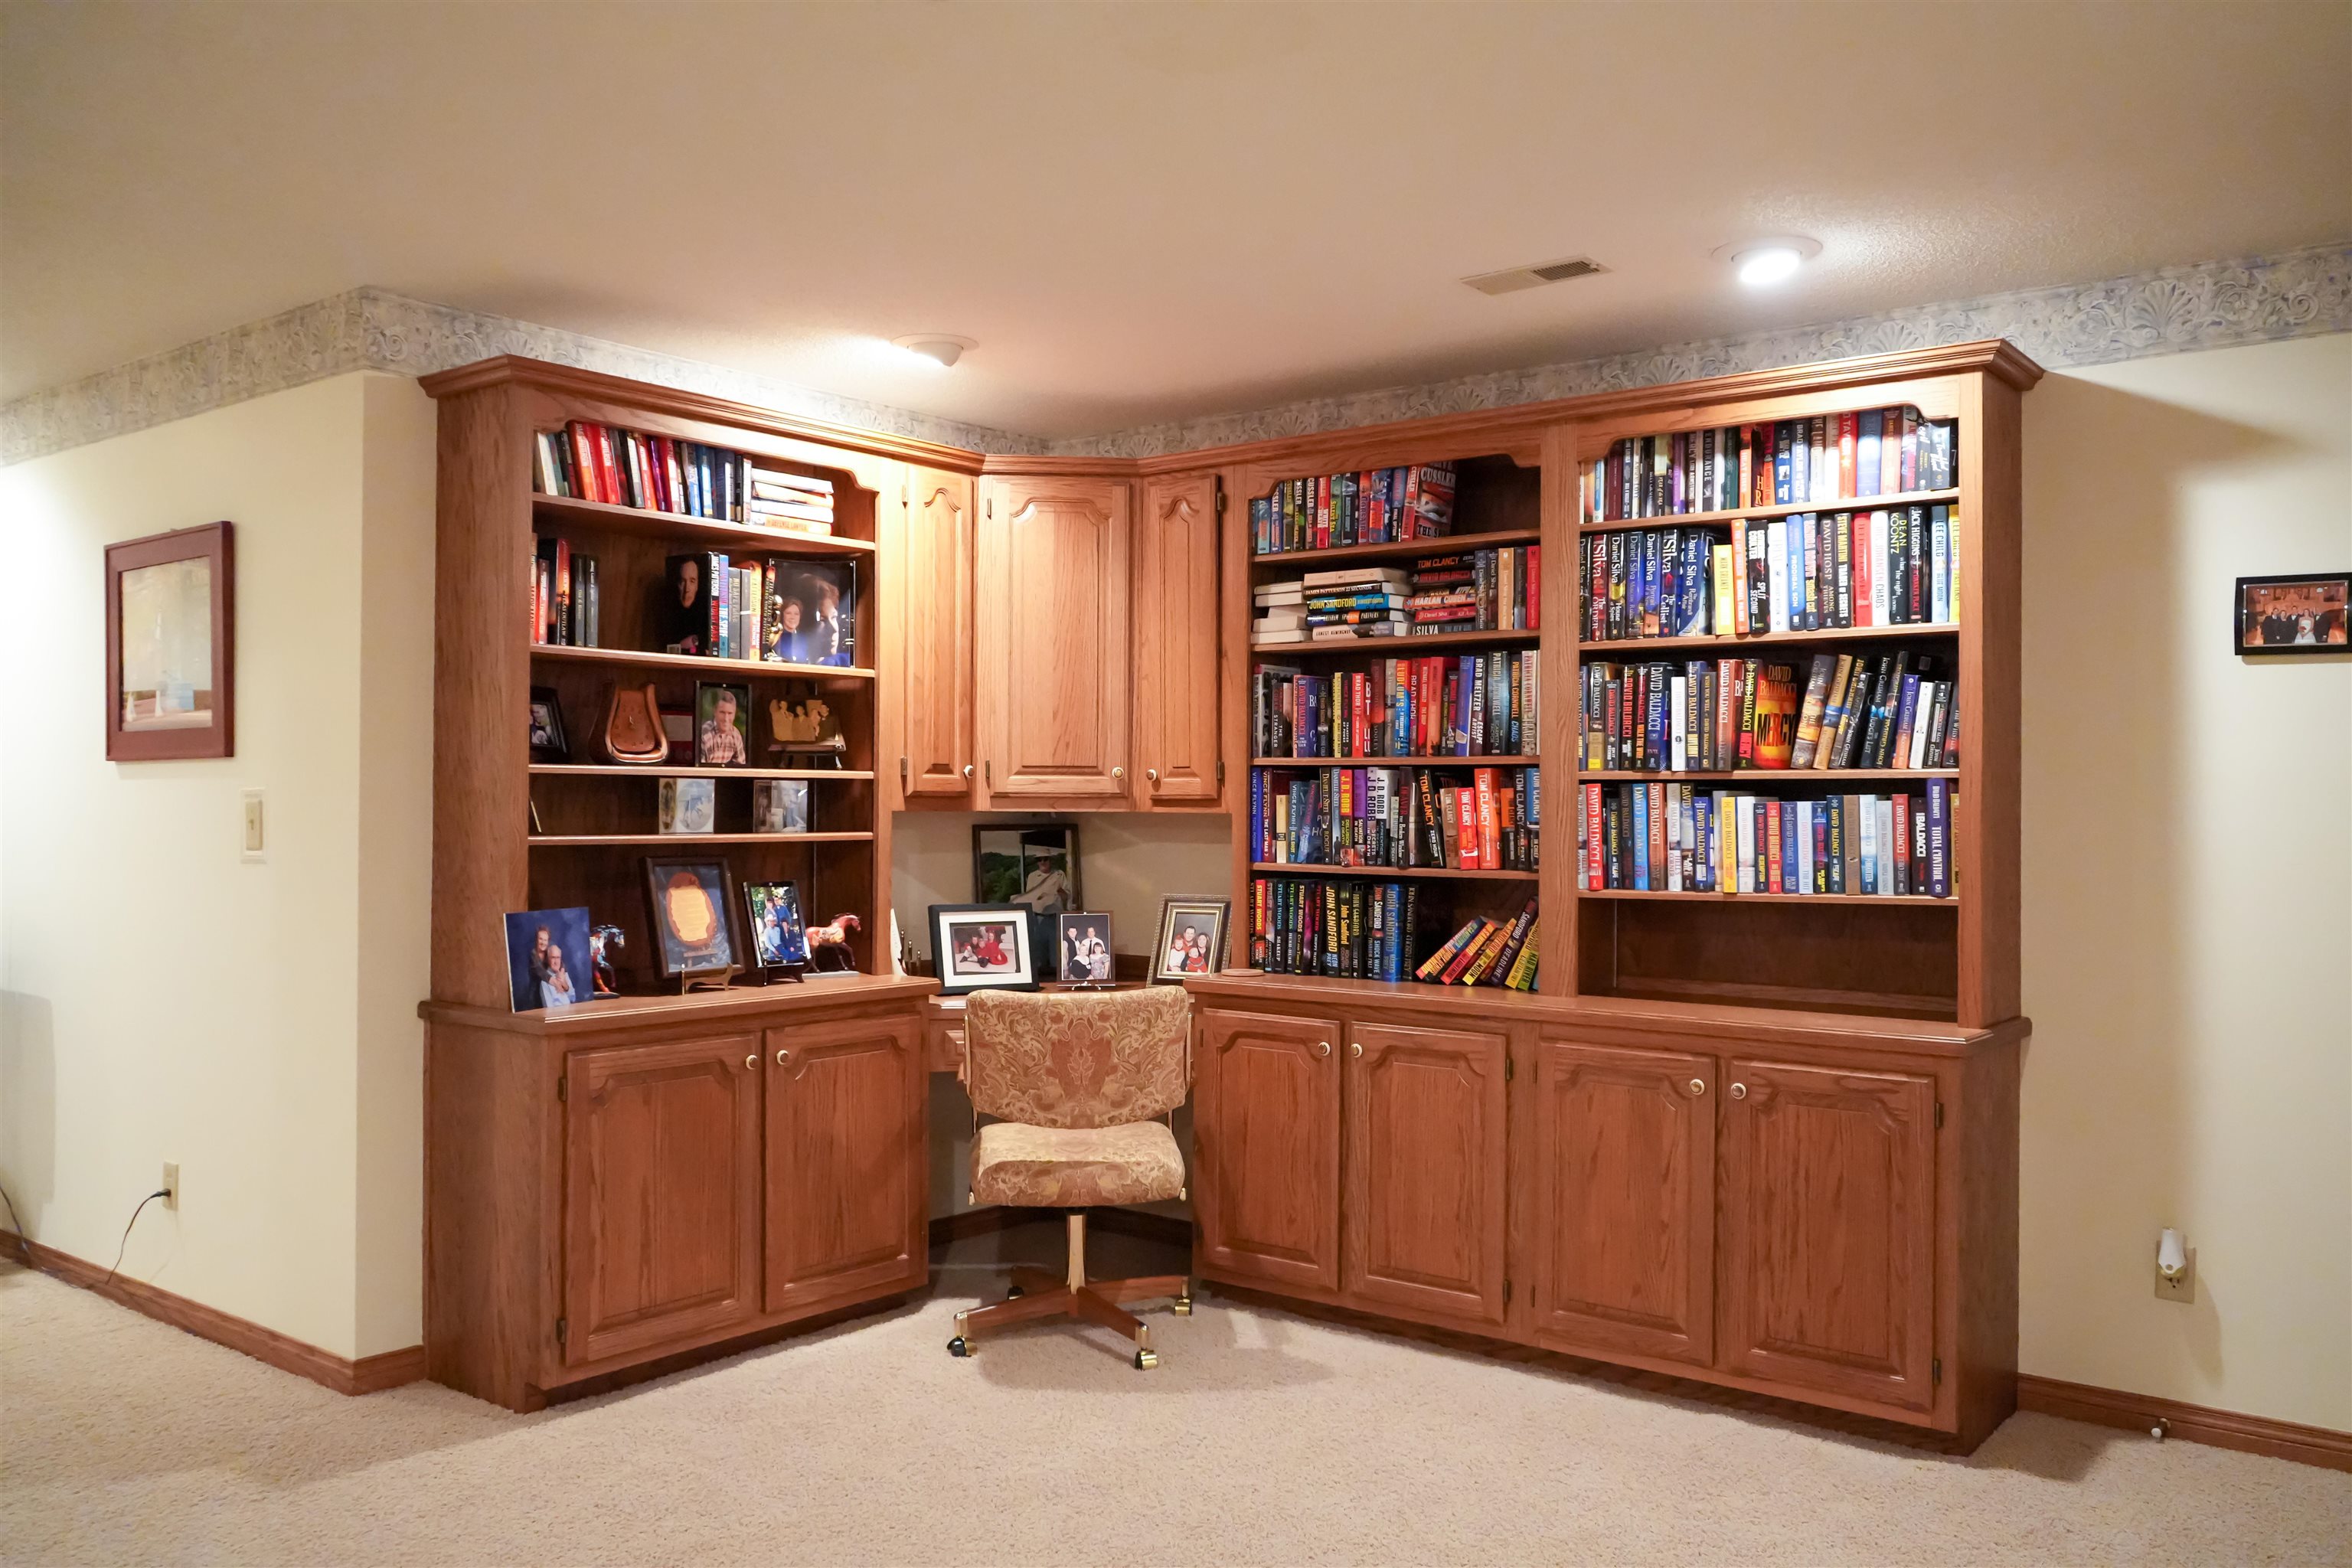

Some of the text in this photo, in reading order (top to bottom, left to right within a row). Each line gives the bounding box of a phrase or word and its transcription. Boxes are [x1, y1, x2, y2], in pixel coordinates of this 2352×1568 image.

[1917, 426, 1930, 444] evil
[1704, 433, 1712, 482] ENDURANCE
[1408, 467, 1416, 492] CUSSLER
[1420, 467, 1456, 488] CUSSLER
[1823, 520, 1831, 551] DAVID
[1890, 512, 1899, 554] KOONTZ
[1592, 544, 1606, 577] Silva
[1611, 537, 1620, 563] Daniel
[1646, 534, 1655, 560] Daniel
[1418, 557, 1460, 568] TOM CLANCY
[1611, 564, 1620, 583] Silva
[1646, 560, 1655, 581] Silva
[1661, 539, 1677, 606] Silva The
[1824, 553, 1832, 580] HOSP
[1309, 598, 1357, 609] JOHN SANDFORD
[1414, 596, 1441, 606] HARLAN
[1757, 581, 1766, 599] SPLIT
[719, 608, 728, 637] THE SPIRE
[1416, 625, 1439, 635] SILVA
[1475, 658, 1483, 678] BRAD
[1769, 665, 1792, 681] DAVID
[1473, 680, 1482, 711] MELTZER
[1648, 666, 1663, 730] DAVID BALDACCI
[1864, 657, 1890, 753] JOHN GRISHAM JUDGE'S LIST
[1756, 712, 1797, 747] MERCY
[1841, 743, 1851, 766] GRISHAM
[1419, 775, 1429, 792] TOM
[1515, 773, 1524, 791] TOM
[1377, 795, 1385, 815] ROBB
[1423, 793, 1434, 826] CLANCY
[1461, 791, 1471, 826] TOM CLANCY
[1516, 793, 1524, 826] CLANCY
[1650, 786, 1659, 808] DAVID
[1589, 787, 1599, 861] DAVID BALDACCI
[1651, 809, 1660, 844] BALDACCI
[1896, 805, 1905, 823] DAVID
[1697, 809, 1705, 862] DAVID BALDACCI
[1769, 817, 1779, 861] DAVID BALDACCI
[1831, 828, 1840, 856] BALDACCI
[1916, 815, 1926, 858] BALDACCI
[1932, 786, 1942, 881] DAVID BALDACCI TOTAL CONTROL
[1326, 886, 1335, 910] JOHN
[1374, 887, 1383, 900] JOHN
[1341, 904, 1349, 918] John
[1374, 901, 1383, 929] SANDFORD
[1385, 889, 1396, 952] JOHN SANDFORD
[1327, 910, 1338, 952] SANDFORD
[1341, 919, 1349, 945] Sandford
[1468, 926, 1511, 979] SANDFORD MOON
[1494, 912, 1530, 978] SANDFORD DEADLINE
